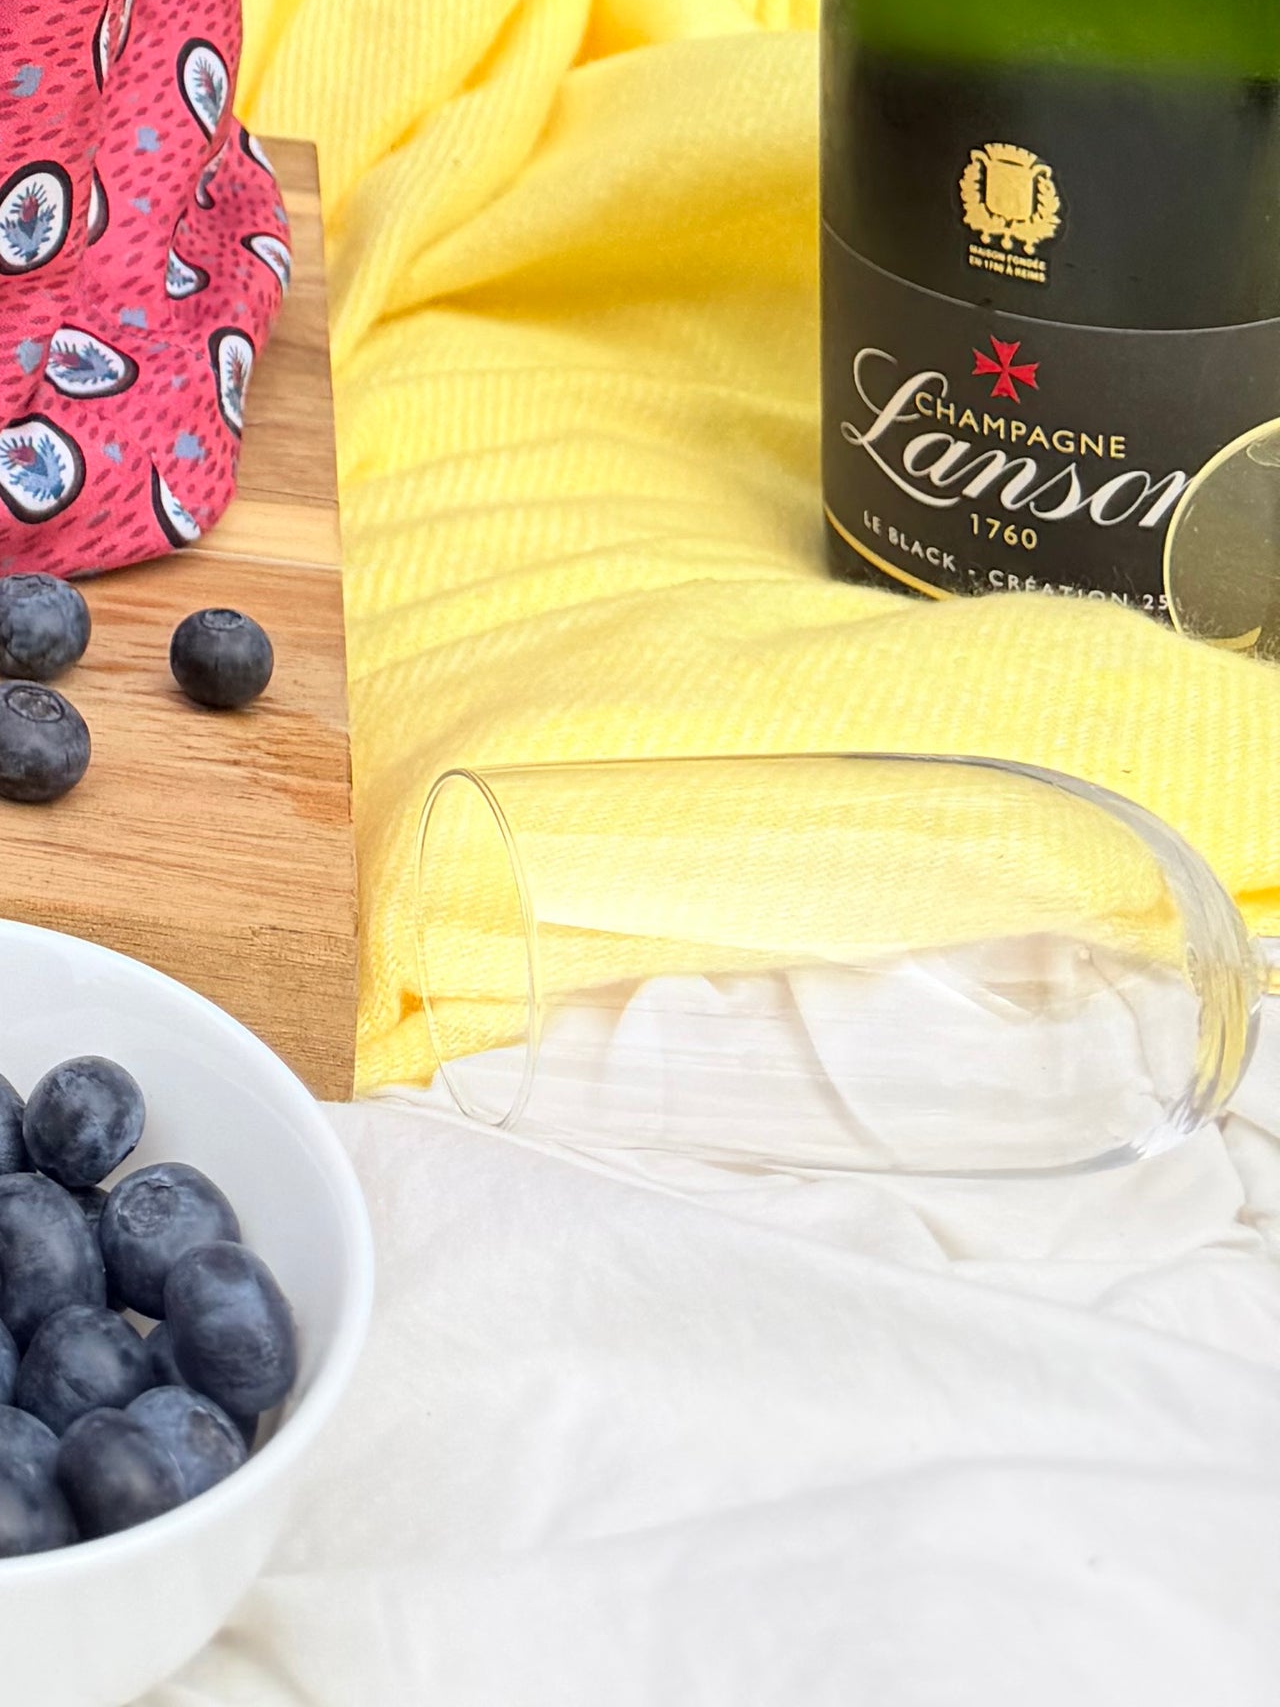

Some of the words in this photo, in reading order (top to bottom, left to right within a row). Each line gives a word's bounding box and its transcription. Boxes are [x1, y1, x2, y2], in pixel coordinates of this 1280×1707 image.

[915, 391, 1126, 459] CHAMPAGNE
[863, 510, 881, 534] LE
[889, 526, 956, 572] BLACK
[970, 513, 1038, 550] 1760
